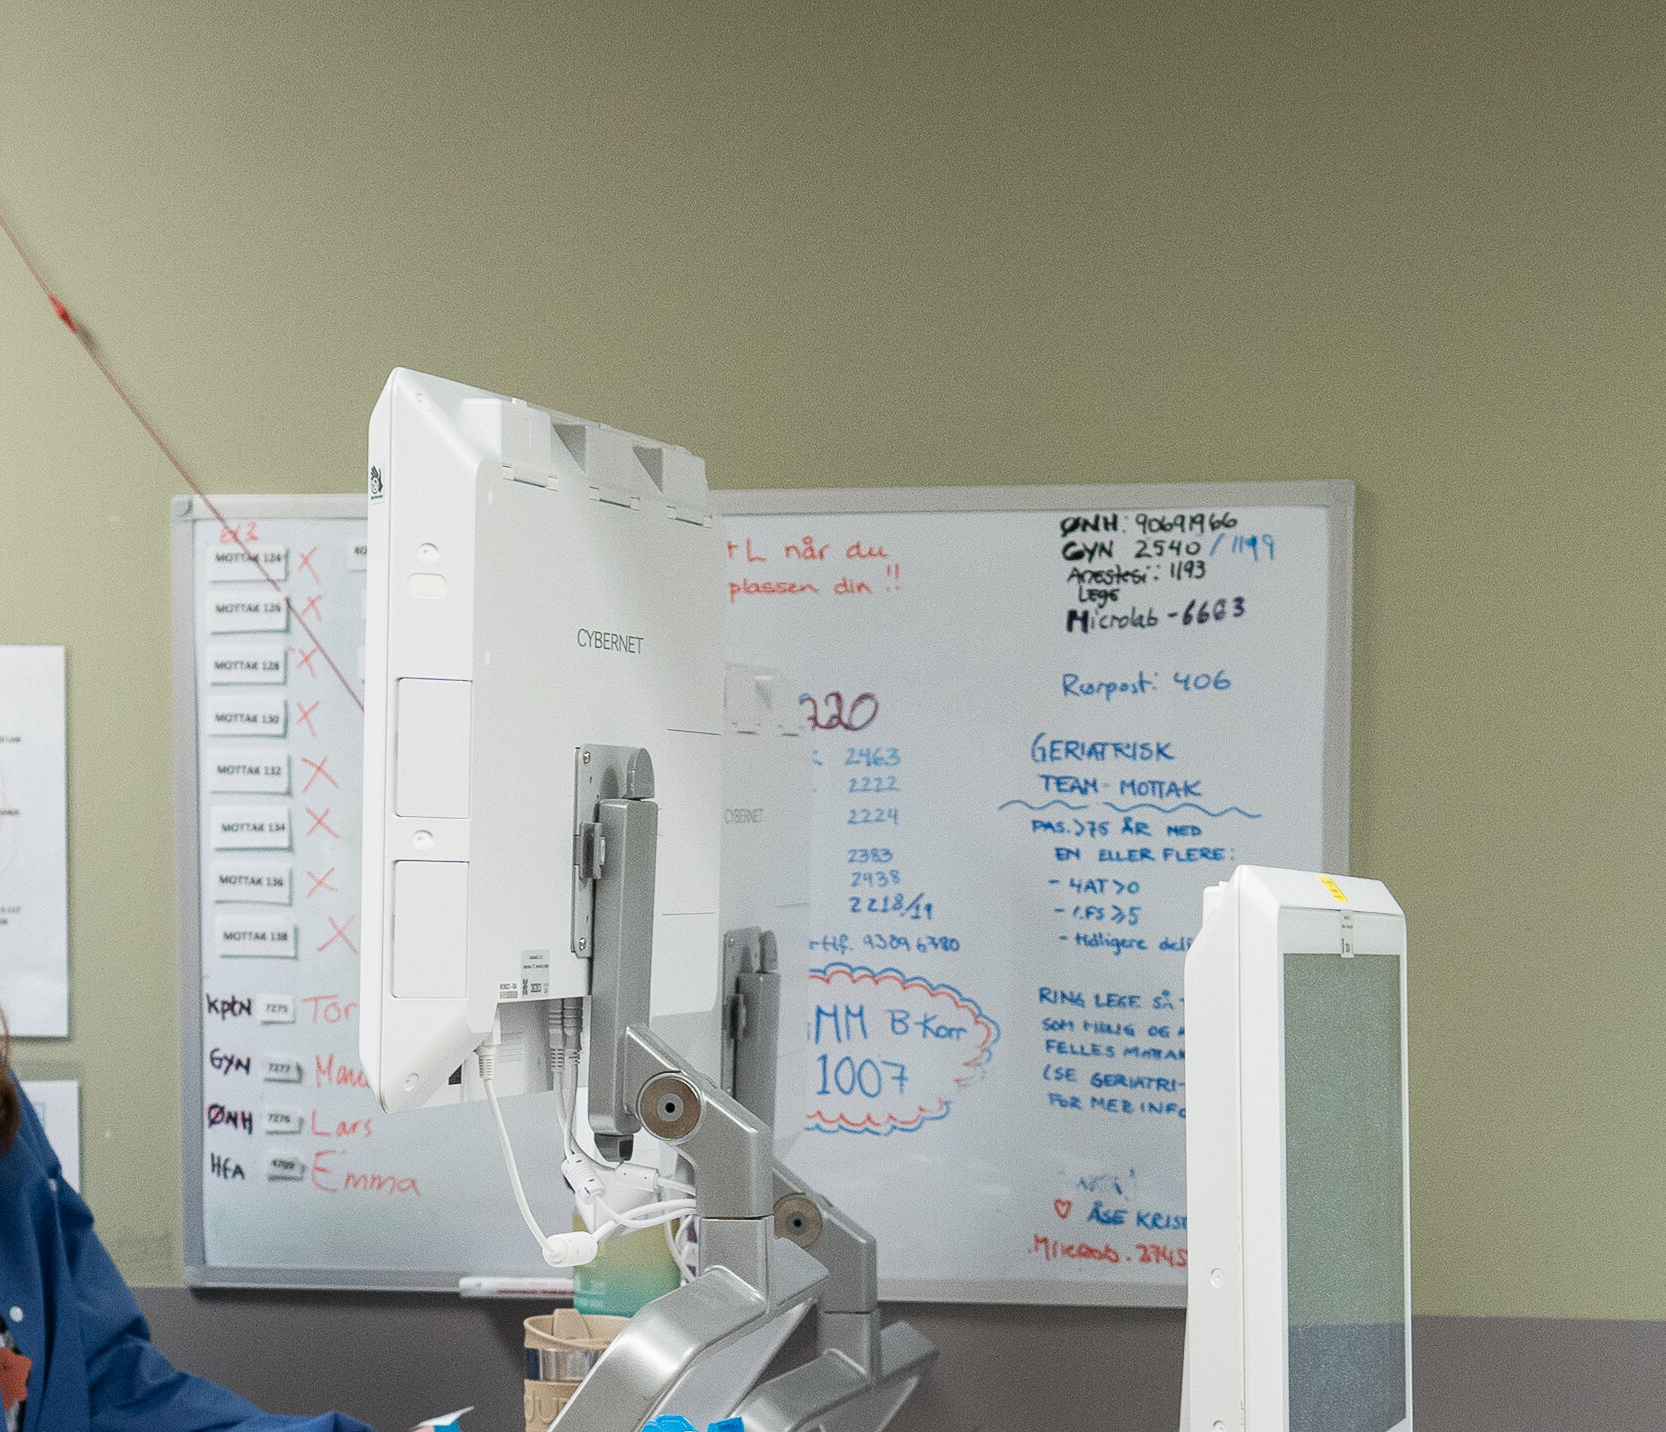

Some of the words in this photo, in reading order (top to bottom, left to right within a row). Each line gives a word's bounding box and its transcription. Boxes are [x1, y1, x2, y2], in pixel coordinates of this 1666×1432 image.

[785, 536, 829, 561] når
[846, 539, 888, 561] du
[1062, 540, 1113, 563] GYN
[1134, 539, 1201, 559] 2540
[834, 577, 872, 596] din
[576, 627, 644, 656] CYBERNET
[1173, 669, 1231, 693] 406
[1031, 731, 1177, 764] GERIATRISK
[847, 807, 900, 825] 2224
[1121, 816, 1153, 837] ÅR
[1055, 847, 1081, 861] EN
[1098, 847, 1155, 862] ELLER
[1045, 1039, 1115, 1058] FELLES
[209, 1047, 252, 1075] GYN
[814, 1052, 909, 1098] 1007
[311, 1109, 374, 1138] Lars
[310, 1149, 422, 1197] Emma
